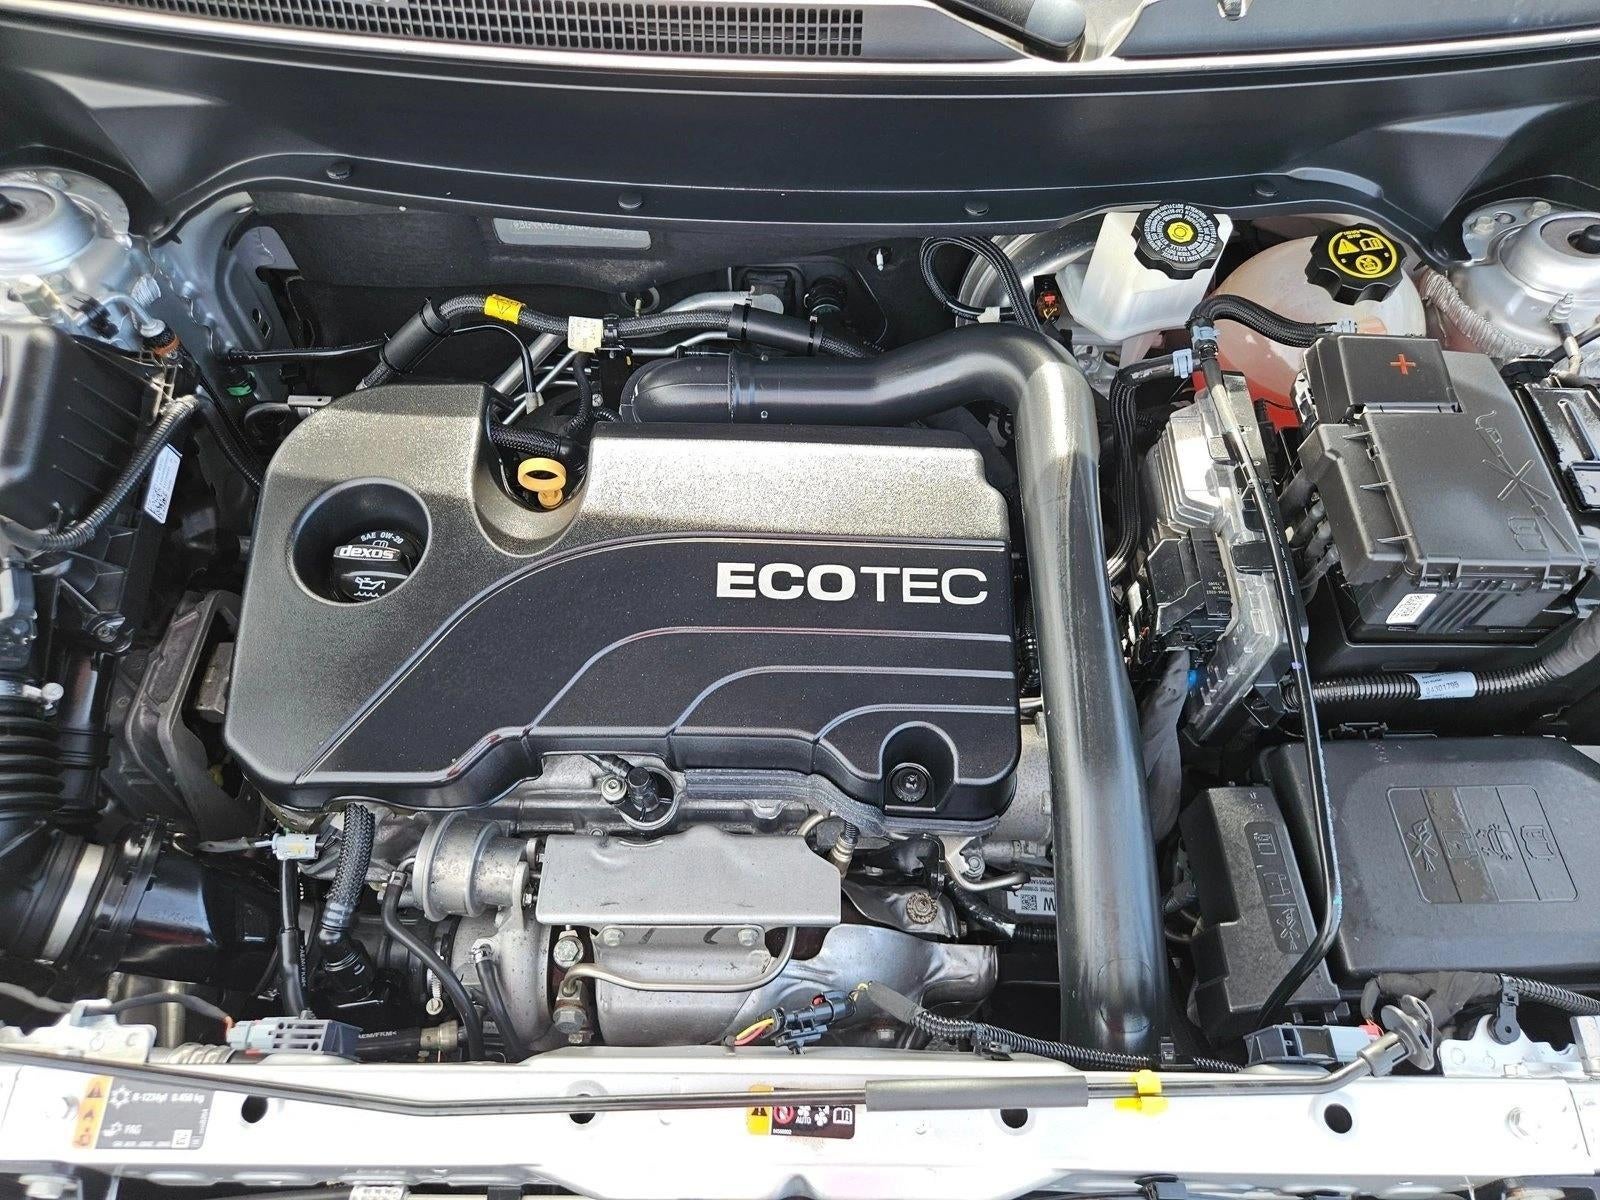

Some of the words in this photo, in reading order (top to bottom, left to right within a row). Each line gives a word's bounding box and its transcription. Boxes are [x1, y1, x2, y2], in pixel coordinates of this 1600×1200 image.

[361, 532, 376, 541] SAE
[380, 531, 404, 544] 0W-20
[340, 545, 393, 559] dexos
[716, 562, 988, 605] ECOTEC
[796, 1116, 811, 1124] AUTO
